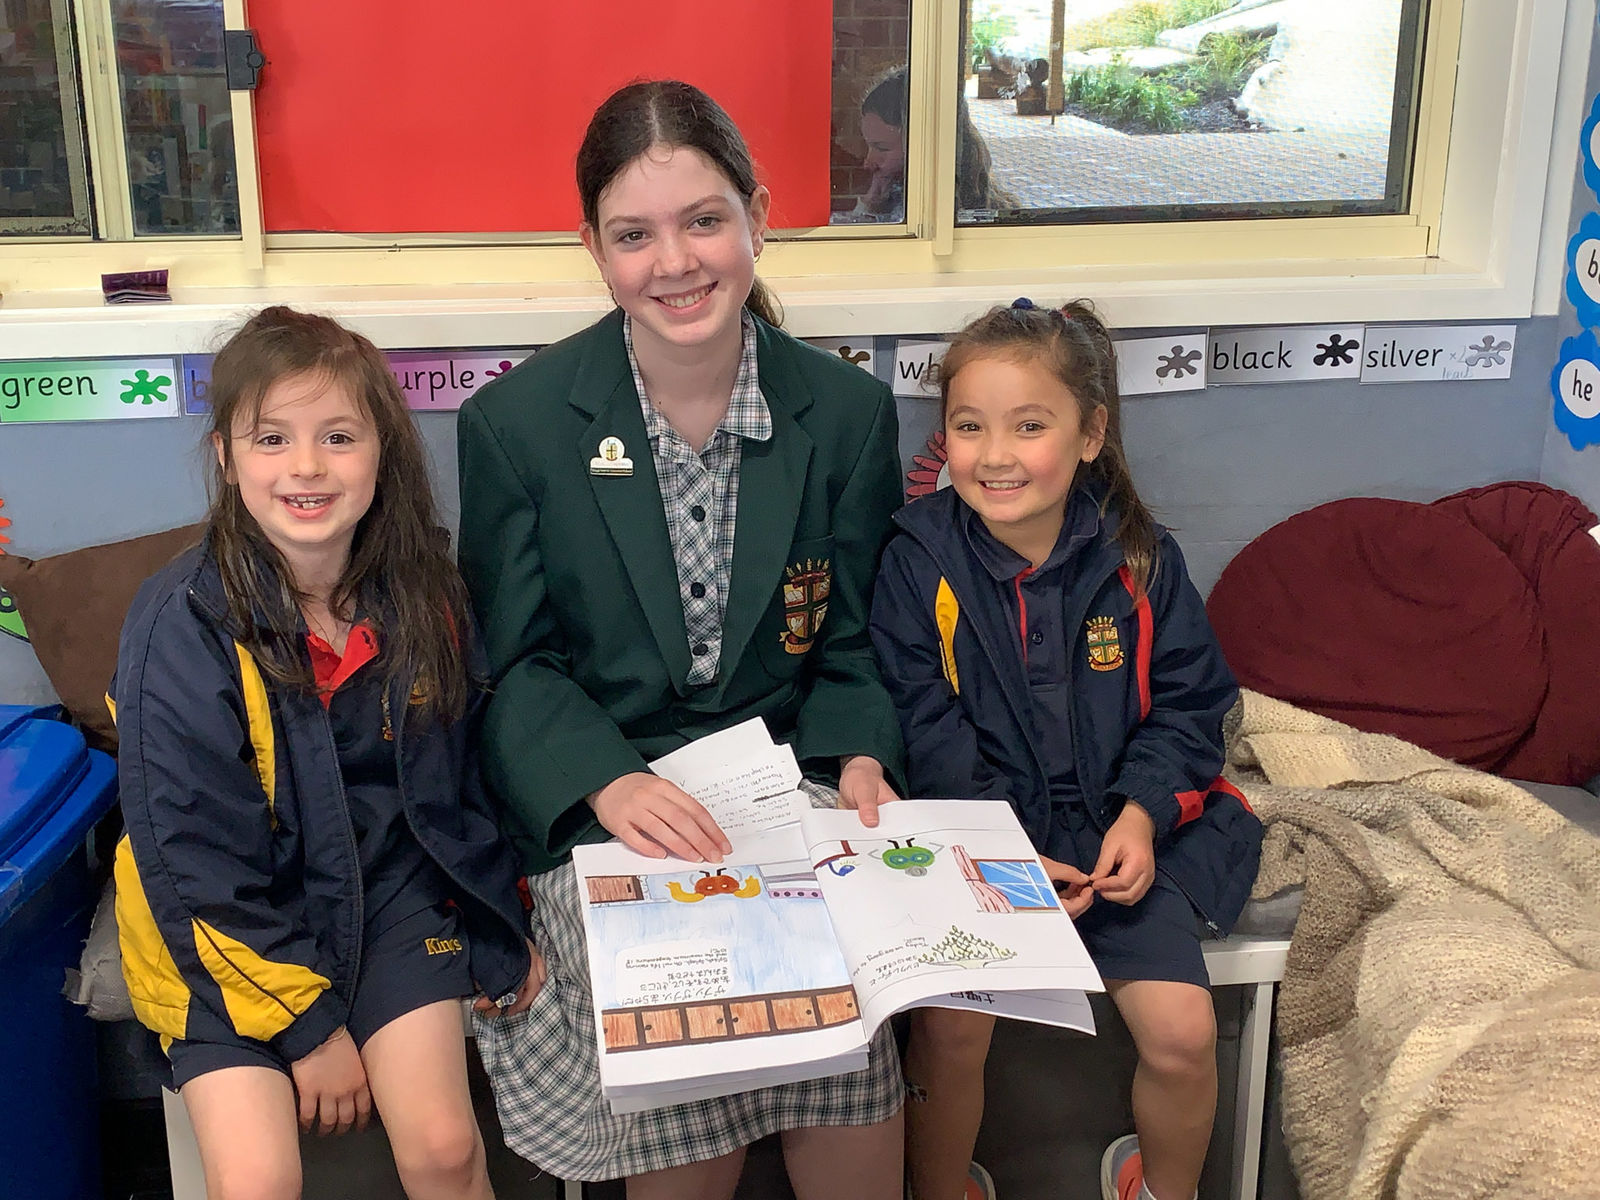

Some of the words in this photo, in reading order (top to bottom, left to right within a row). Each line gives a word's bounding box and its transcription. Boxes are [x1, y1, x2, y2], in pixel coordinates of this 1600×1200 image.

[1588, 249, 1600, 283] b
[1213, 340, 1293, 370] black
[1366, 339, 1443, 368] silver
[1, 376, 98, 409] green
[393, 360, 475, 402] urple
[1572, 368, 1593, 402] he
[424, 937, 463, 956] Kings
